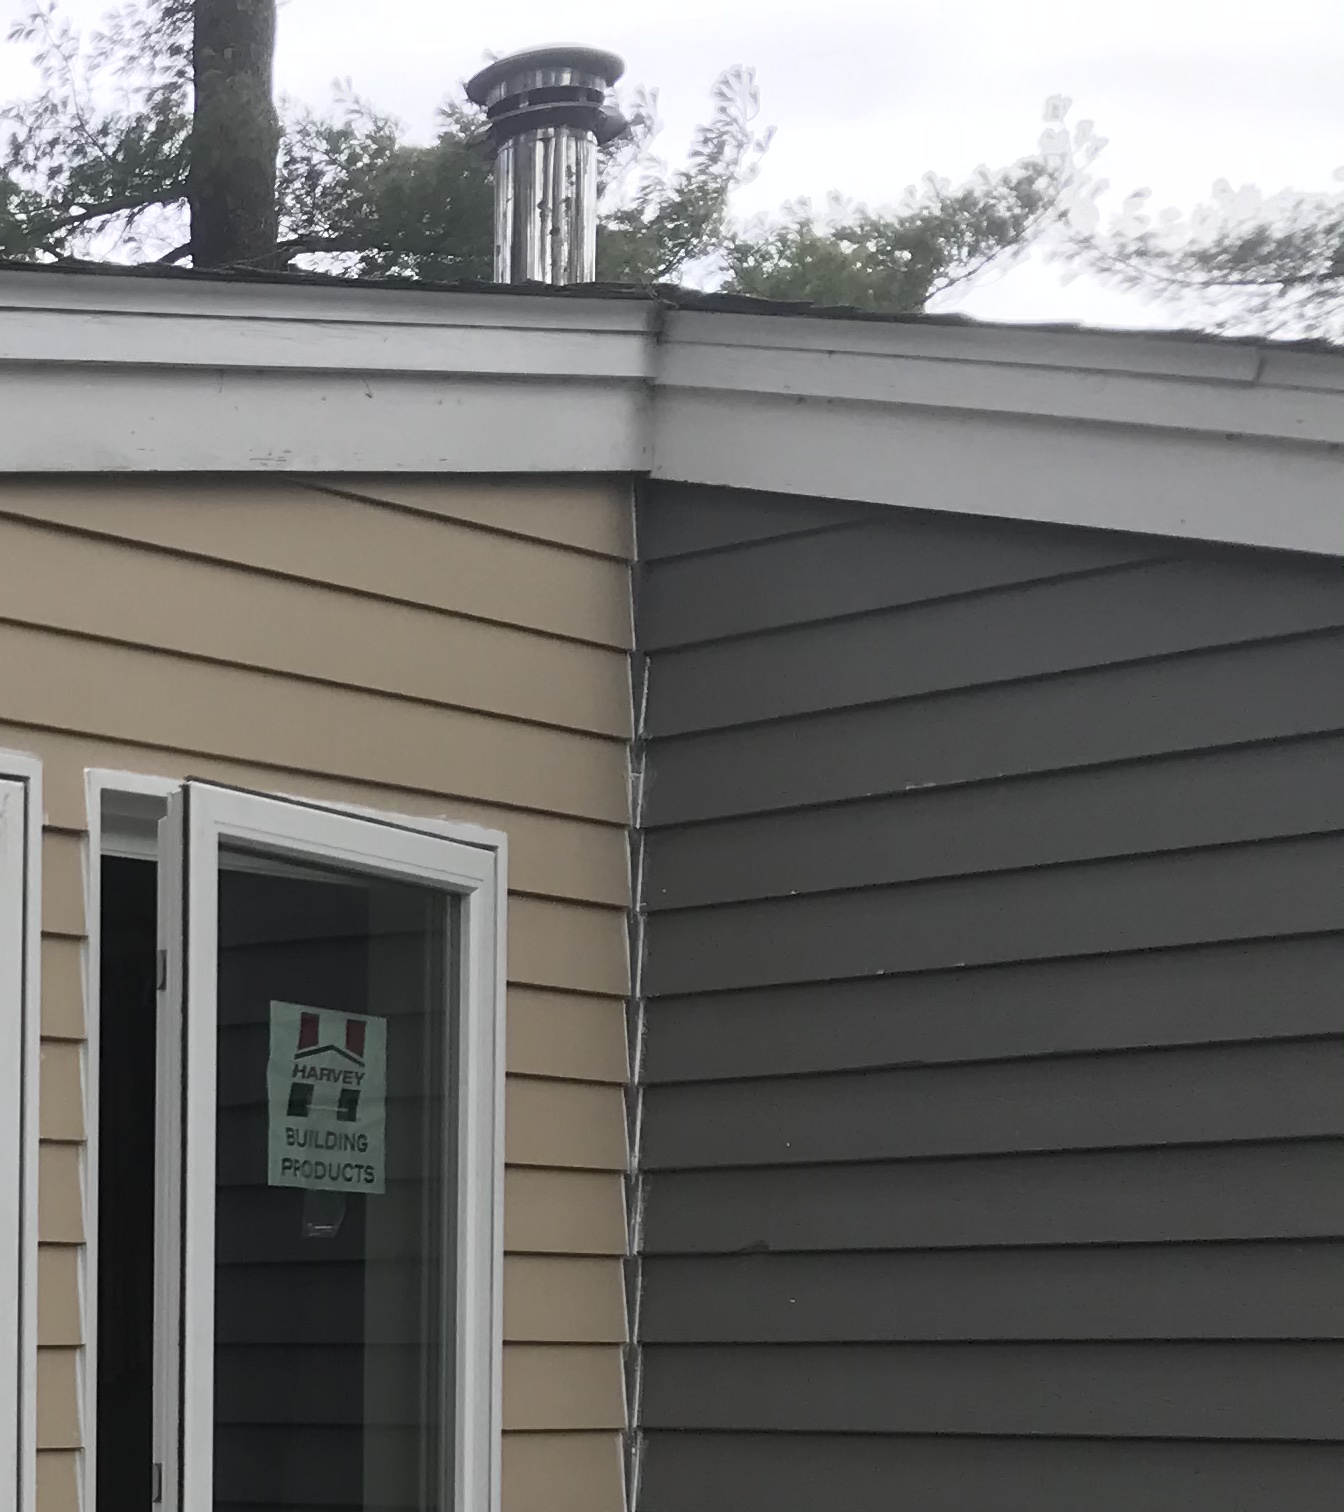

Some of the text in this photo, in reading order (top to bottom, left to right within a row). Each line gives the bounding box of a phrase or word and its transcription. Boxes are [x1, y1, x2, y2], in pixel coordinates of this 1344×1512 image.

[291, 1064, 366, 1086] HARVEY
[285, 1127, 368, 1153] BUILDING
[281, 1157, 375, 1185] PRODUCTS
